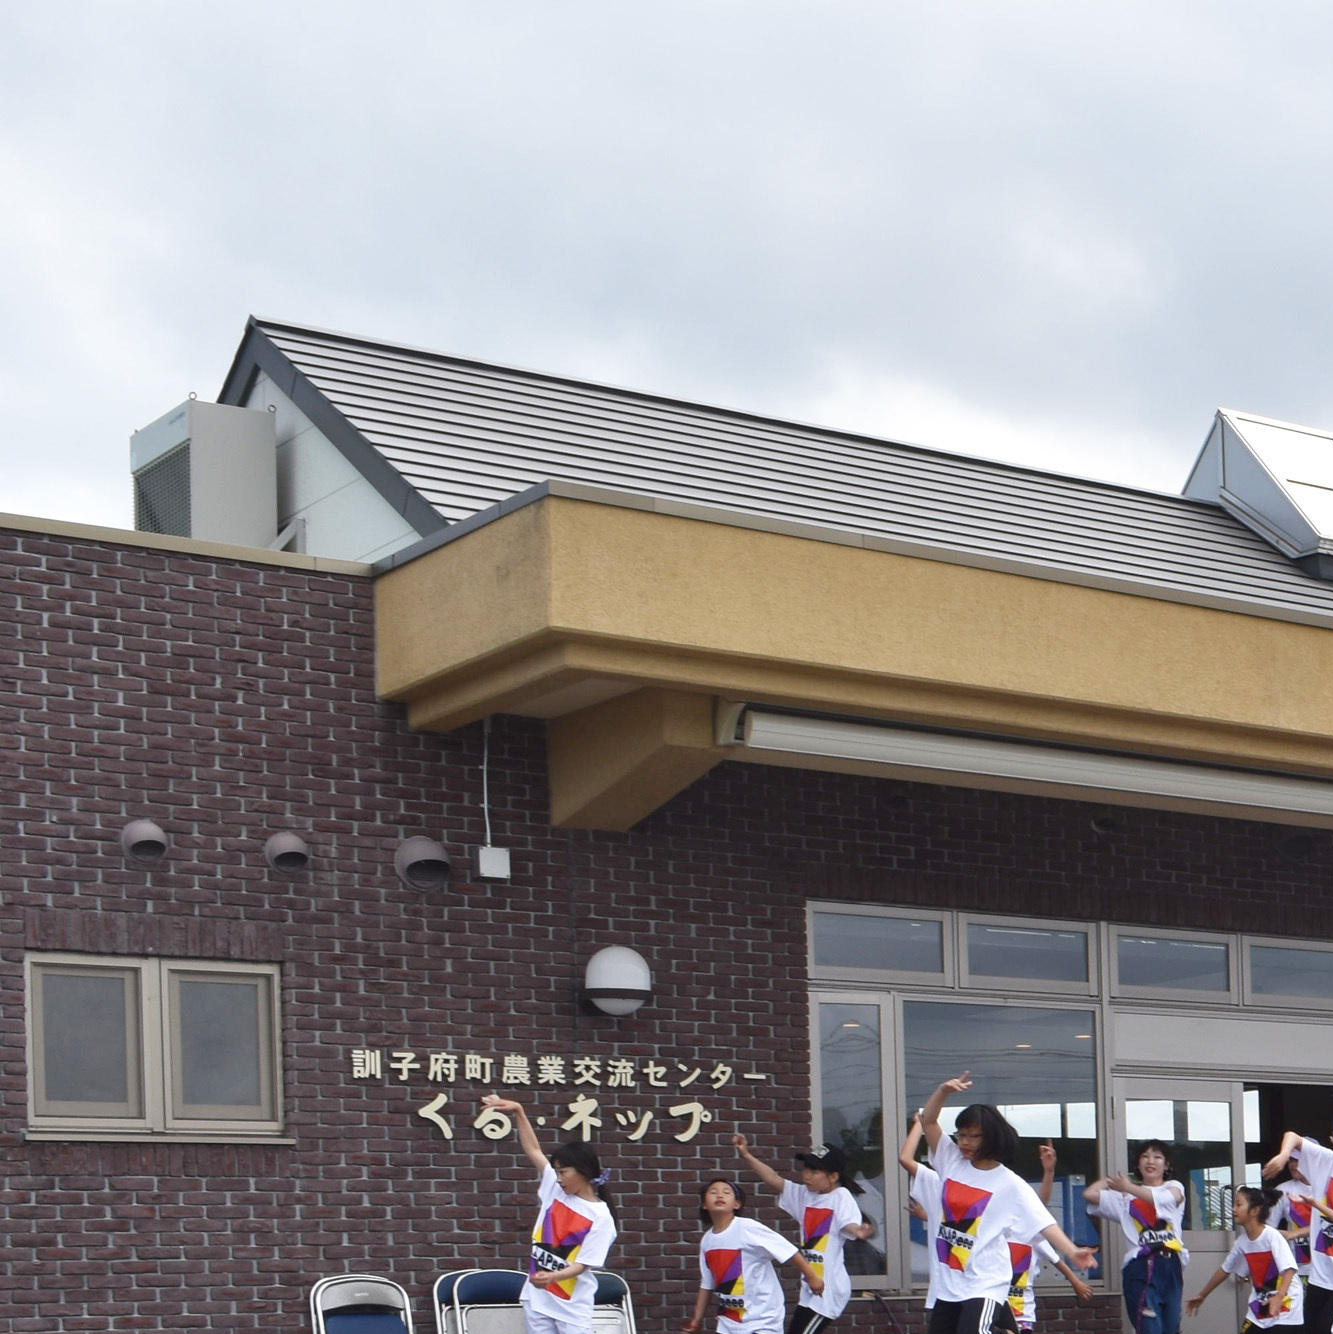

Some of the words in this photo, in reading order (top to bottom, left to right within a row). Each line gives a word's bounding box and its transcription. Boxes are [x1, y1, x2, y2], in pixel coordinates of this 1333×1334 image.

[351, 1049, 767, 1090] 訓子府町農業交流センター
